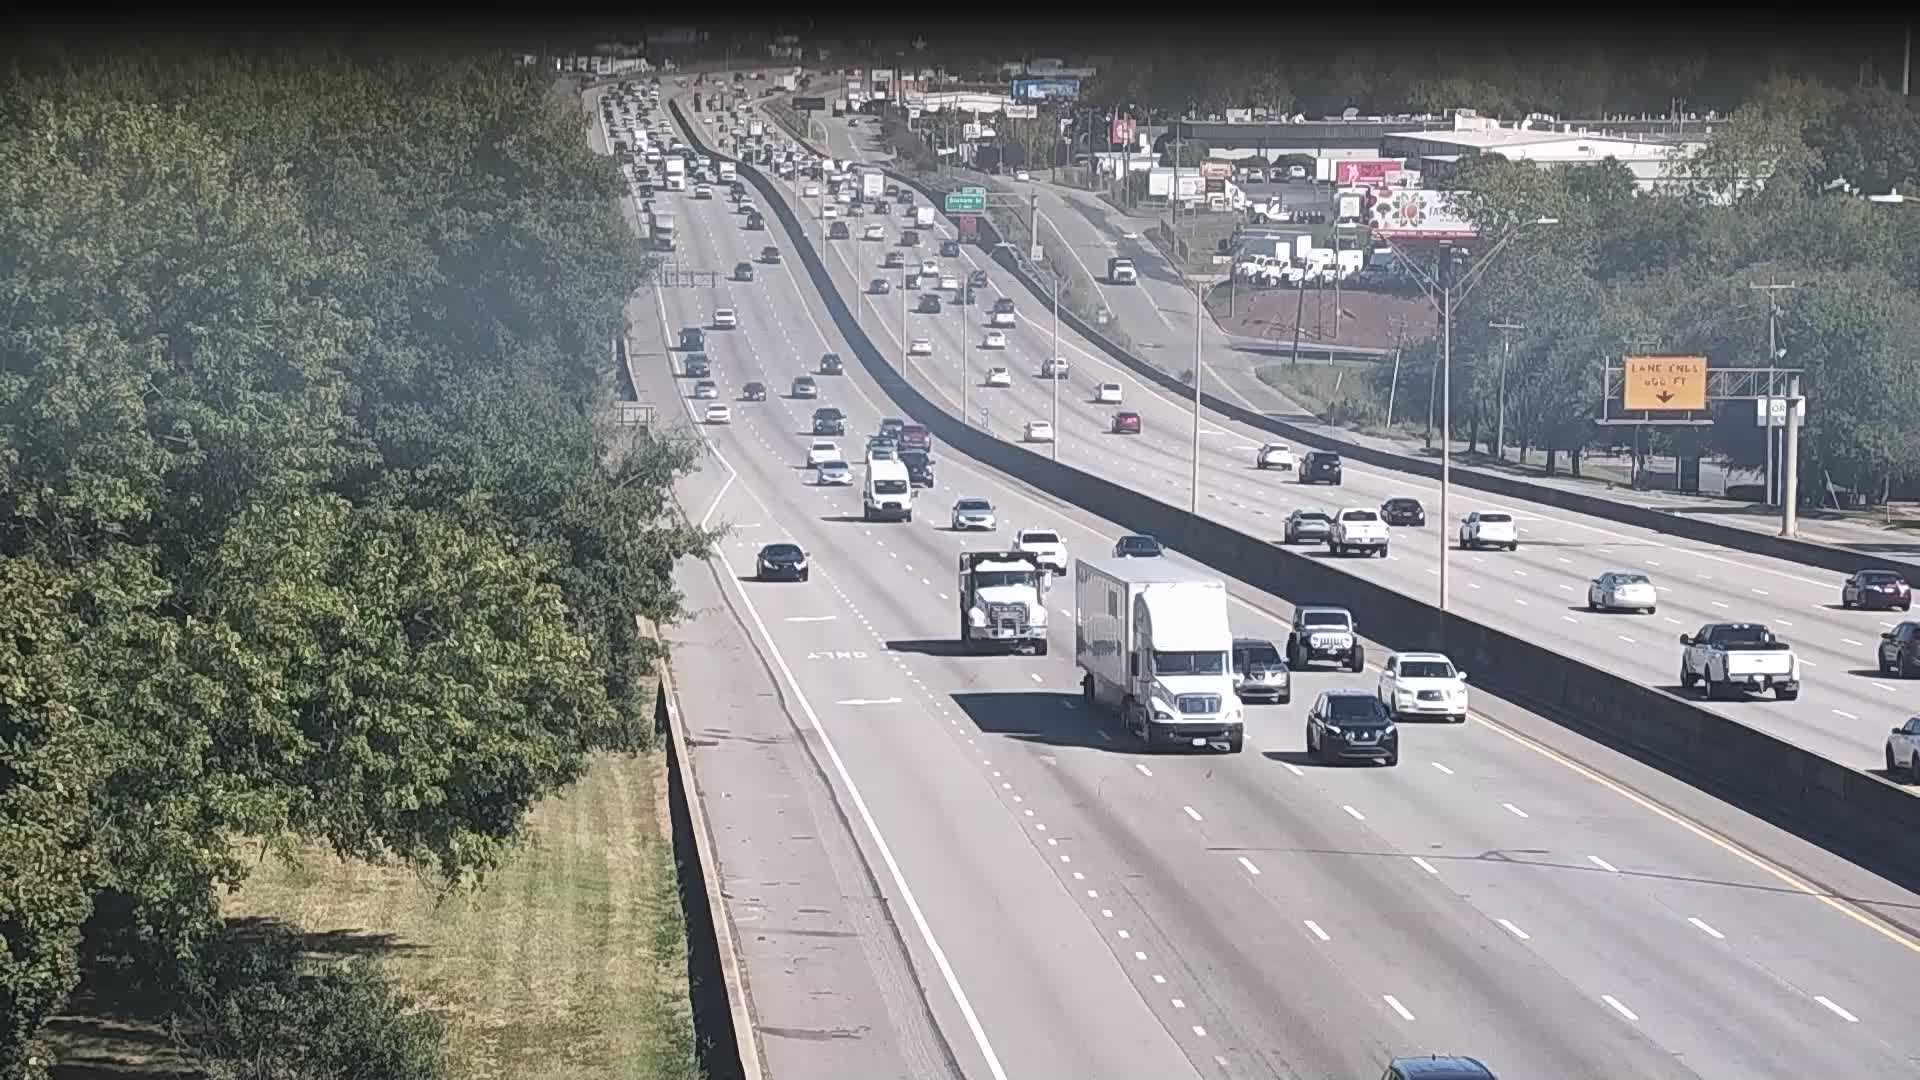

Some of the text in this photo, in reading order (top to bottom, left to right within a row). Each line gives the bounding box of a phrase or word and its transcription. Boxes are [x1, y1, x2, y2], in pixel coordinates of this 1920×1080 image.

[1631, 364, 1661, 373] LANE
[1673, 377, 1687, 386] FT
[807, 651, 869, 660] ONLY
